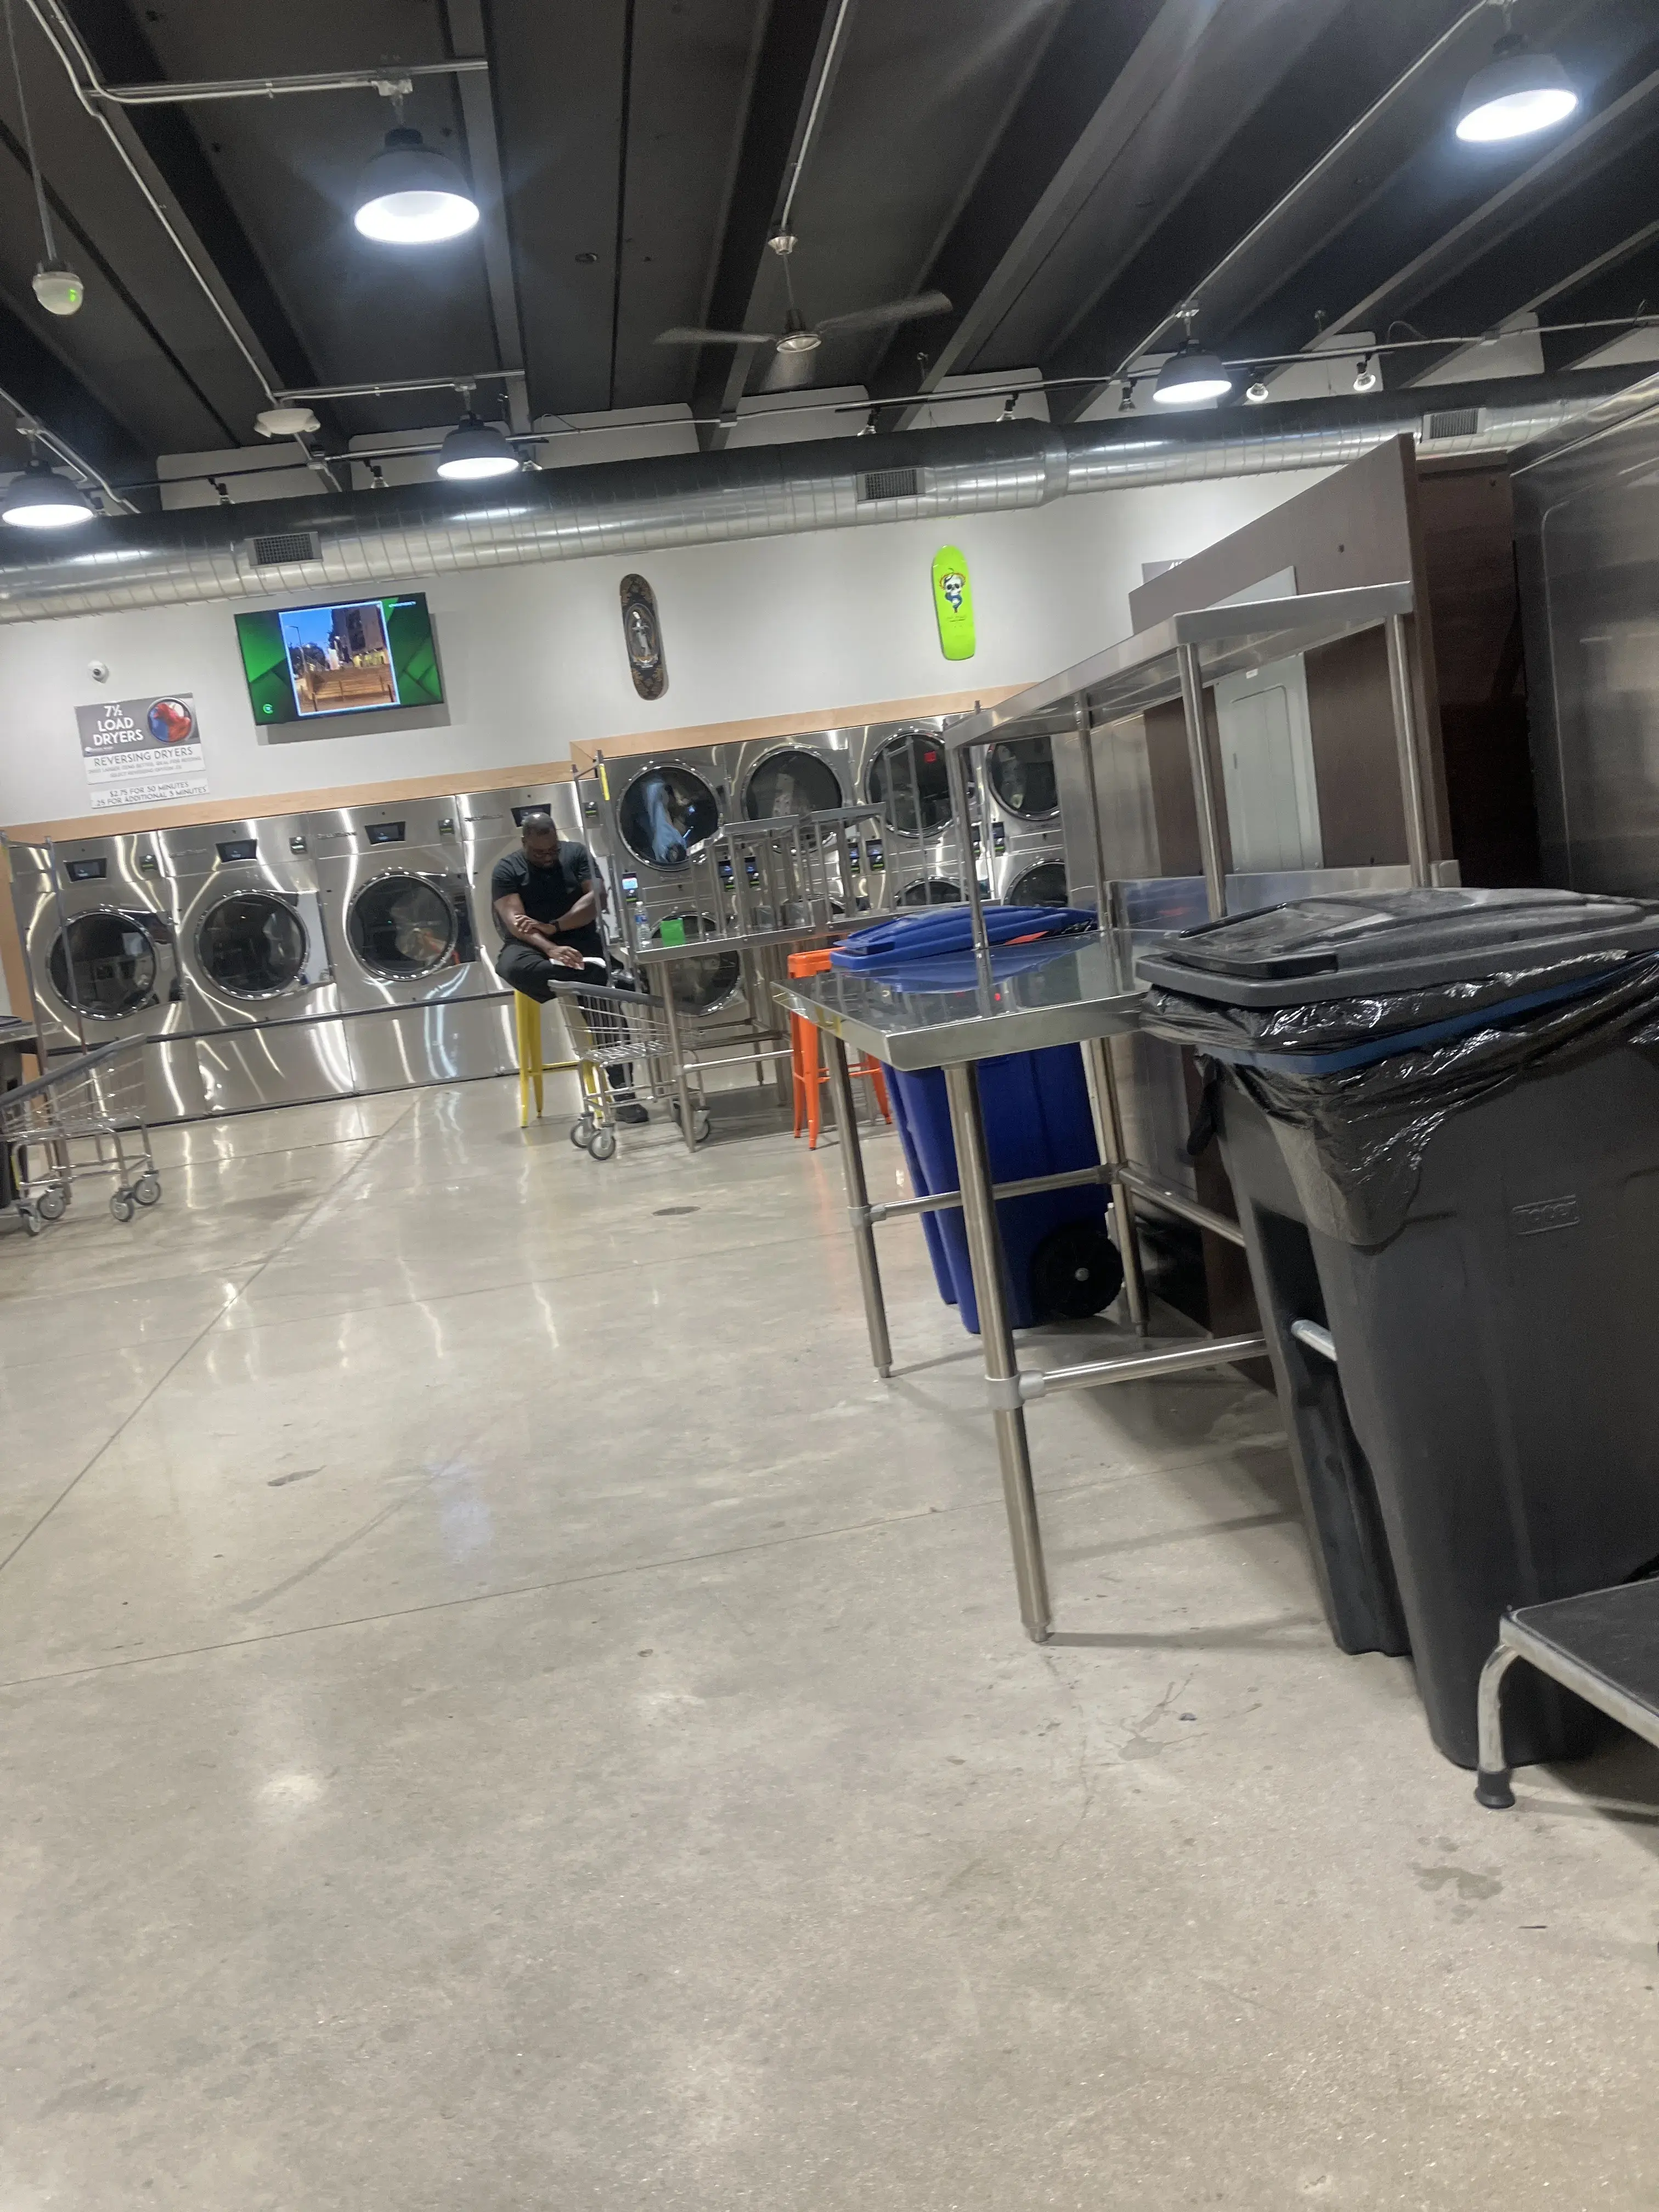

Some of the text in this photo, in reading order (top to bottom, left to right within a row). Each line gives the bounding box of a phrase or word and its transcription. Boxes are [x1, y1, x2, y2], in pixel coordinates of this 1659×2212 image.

[97, 716, 134, 732] LOAD
[93, 729, 144, 746] DRYERS
[94, 752, 151, 766] REVERSING
[154, 747, 194, 759] DRYERS
[157, 781, 189, 791] MINUTES
[107, 797, 122, 805] FOR
[125, 792, 168, 802] ADDITIONAL
[176, 786, 207, 796] MINUTES
